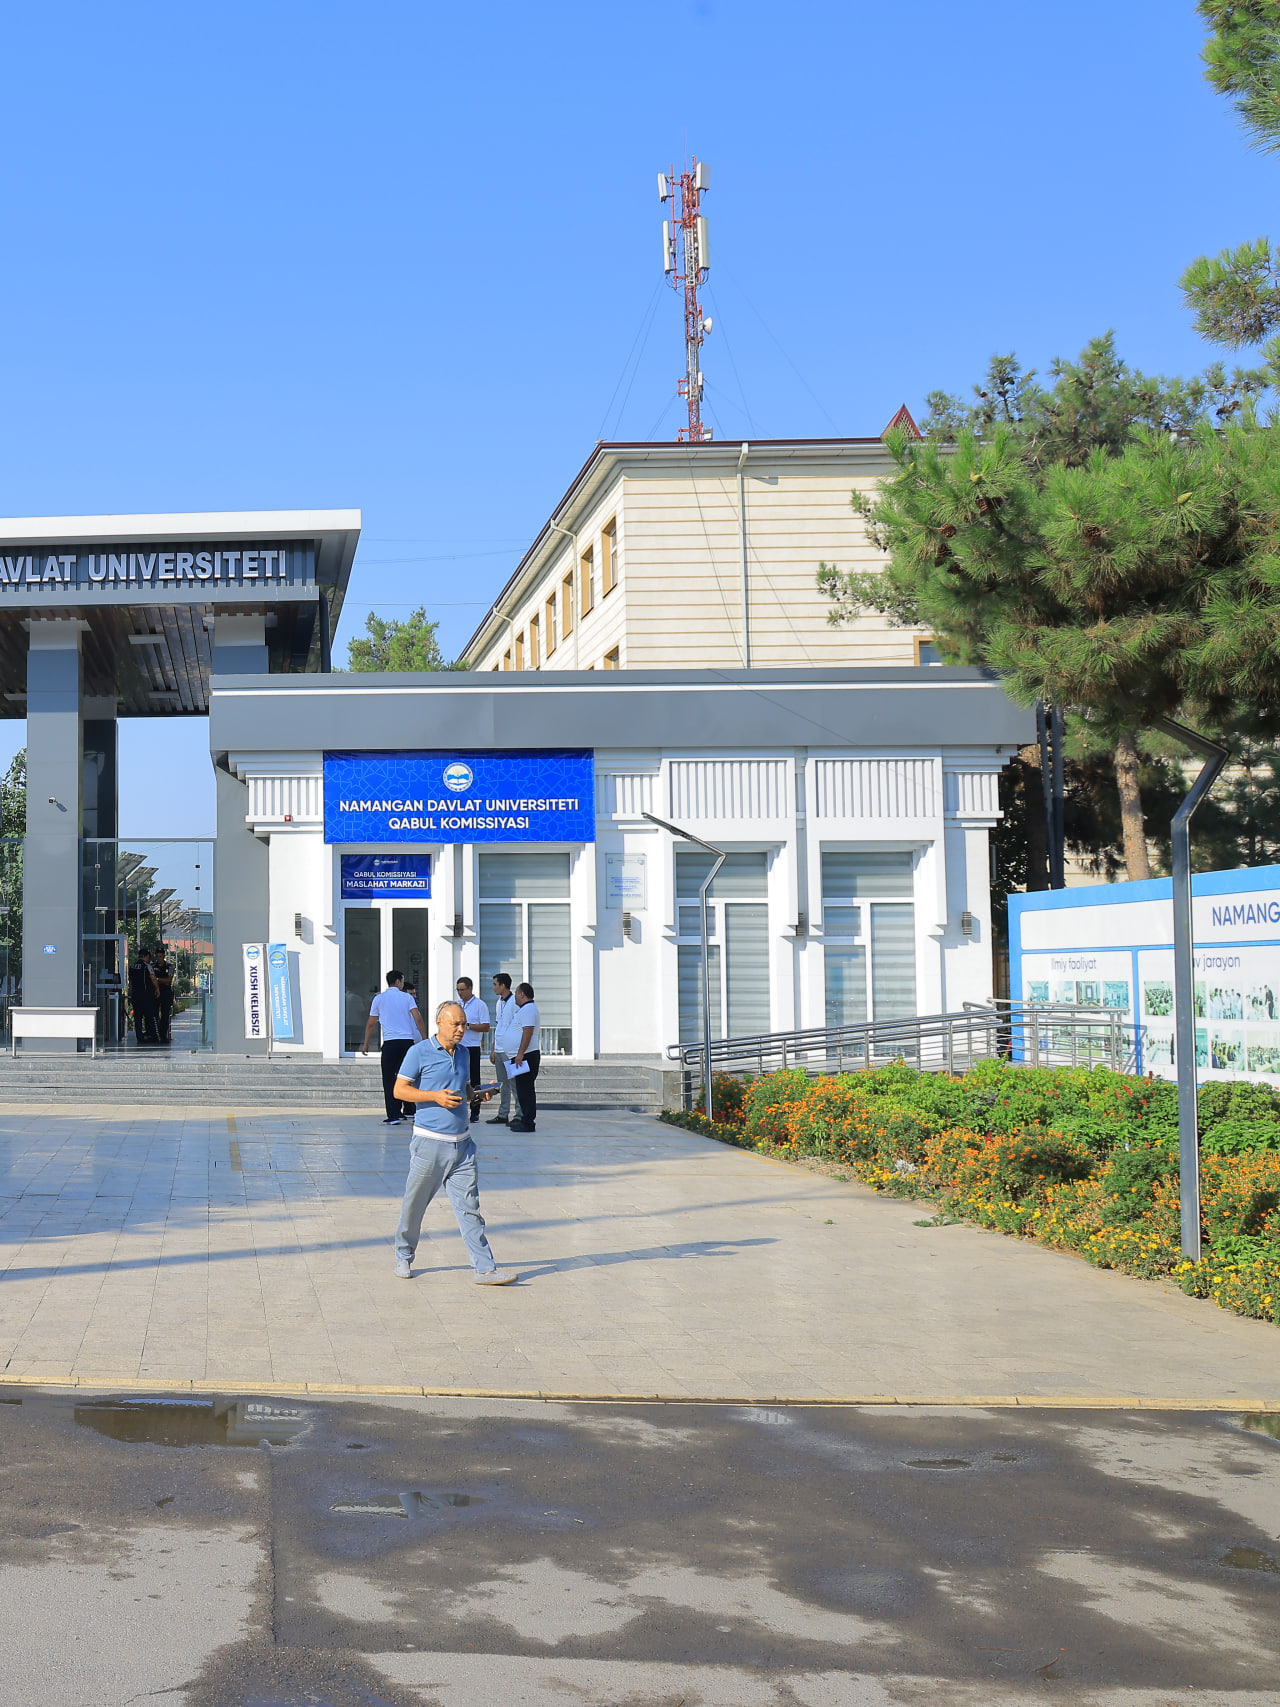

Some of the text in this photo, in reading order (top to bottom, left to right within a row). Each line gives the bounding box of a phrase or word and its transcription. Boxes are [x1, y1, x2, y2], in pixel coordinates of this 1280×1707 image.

[88, 549, 287, 582] UNIVERSITETI
[339, 798, 579, 812] NAMANGAN DAVLAT UNIVERSITETI
[388, 816, 529, 829] QABUL KOMISSIYASI
[346, 880, 426, 888] MASLAHAT MARKAZI
[1202, 953, 1241, 972] jarayon
[249, 965, 261, 1036] XUSH KELIBSIZ!
